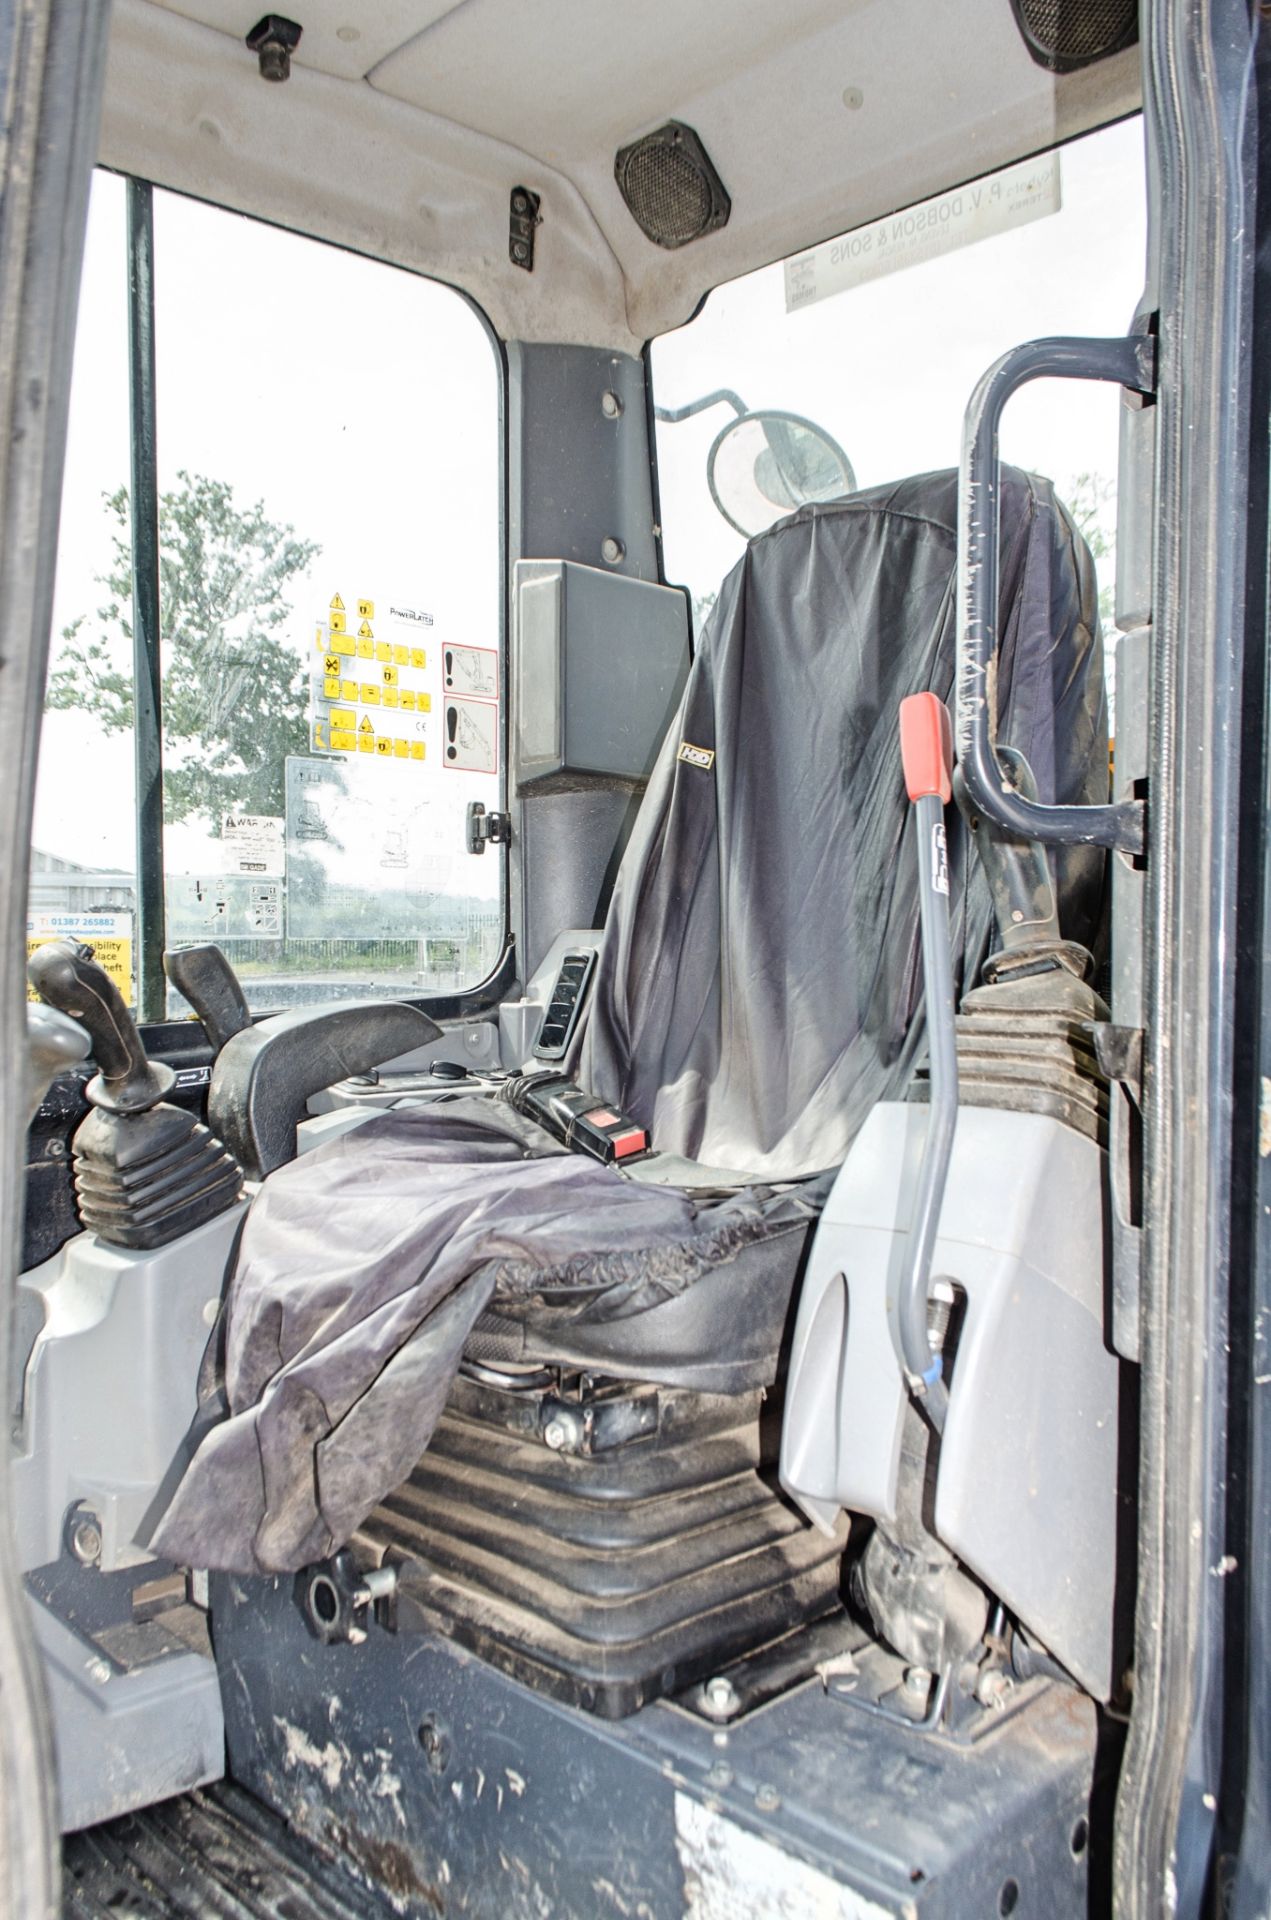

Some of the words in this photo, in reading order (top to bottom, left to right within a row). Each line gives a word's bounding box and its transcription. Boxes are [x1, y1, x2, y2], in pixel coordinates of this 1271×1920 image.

[51, 917, 79, 926] 01387
[83, 917, 114, 926] 265882
[104, 963, 122, 972] heft
